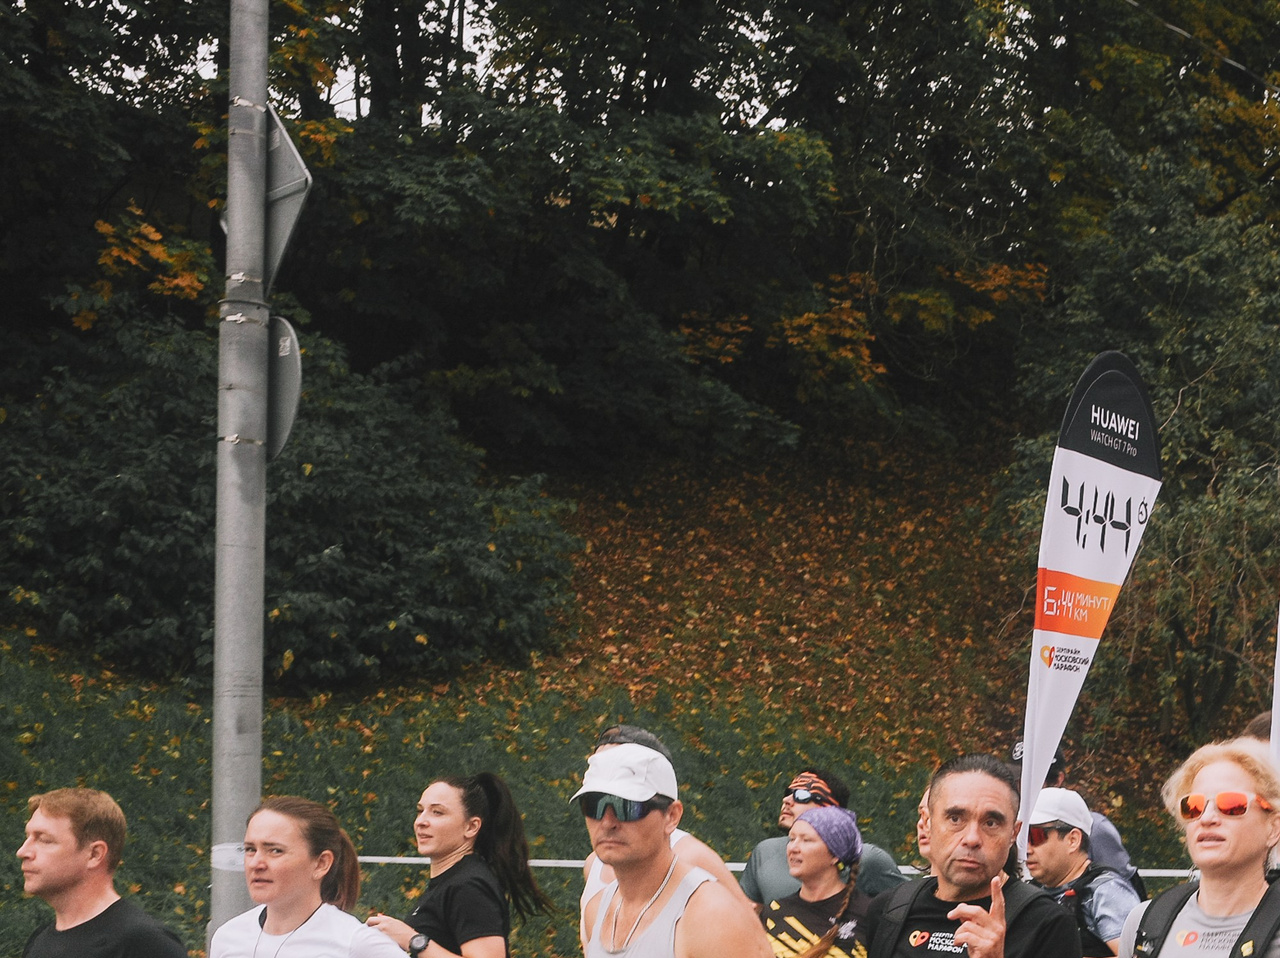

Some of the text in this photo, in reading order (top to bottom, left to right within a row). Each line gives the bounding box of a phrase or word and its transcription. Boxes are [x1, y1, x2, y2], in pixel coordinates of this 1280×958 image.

[1091, 404, 1139, 440] HUAWEI
[1090, 428, 1137, 457] WATCH GT 7 Pro
[1061, 475, 1132, 558] 4:44
[1043, 586, 1076, 619] 6:44
[1073, 607, 1089, 623] КМ
